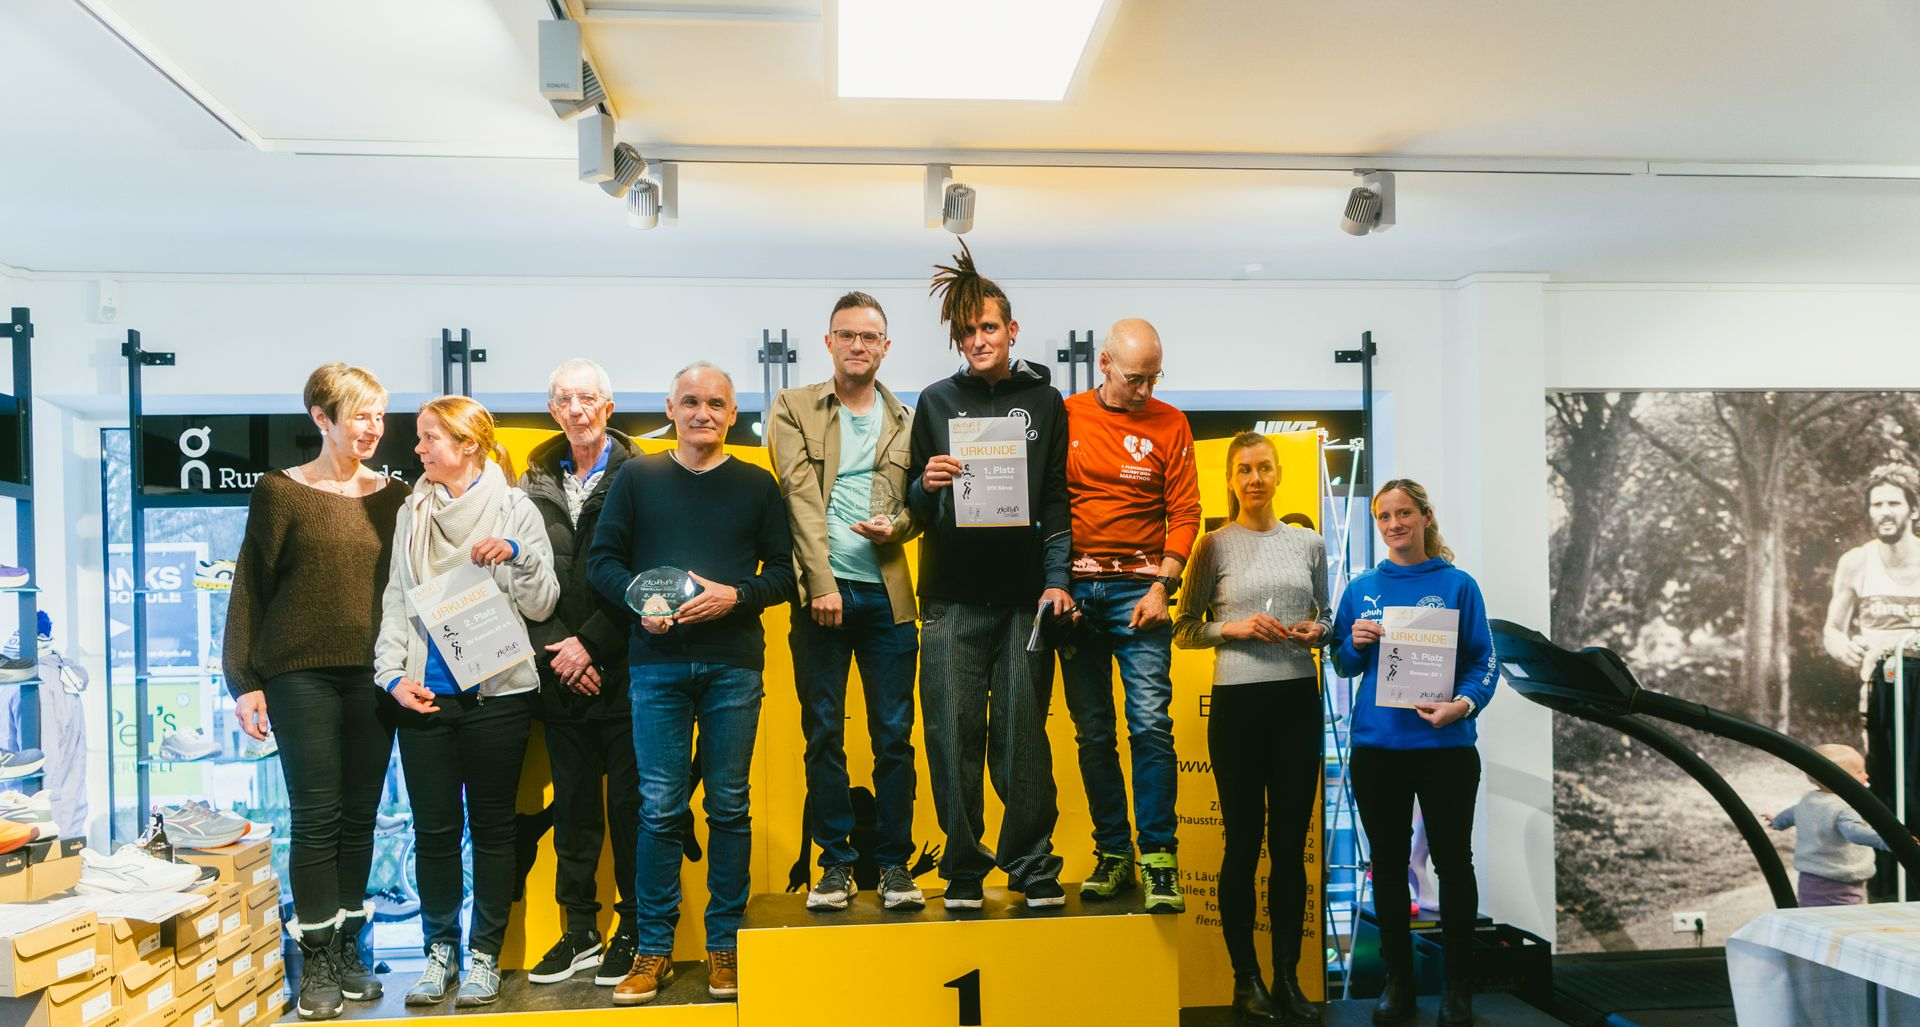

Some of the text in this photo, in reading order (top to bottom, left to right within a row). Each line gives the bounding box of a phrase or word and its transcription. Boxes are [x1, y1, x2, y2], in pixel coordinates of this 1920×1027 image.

[960, 444, 1018, 457] URKUNDE
[983, 465, 1015, 475] 1. Platz
[1119, 473, 1152, 481] MARATHON
[431, 586, 488, 621] URKUNDE
[473, 607, 497, 623] Platz
[1360, 608, 1383, 619] schuh
[1391, 631, 1448, 645] URKUNDE
[1410, 652, 1444, 662] 3. Platz
[943, 968, 982, 1027] 1
